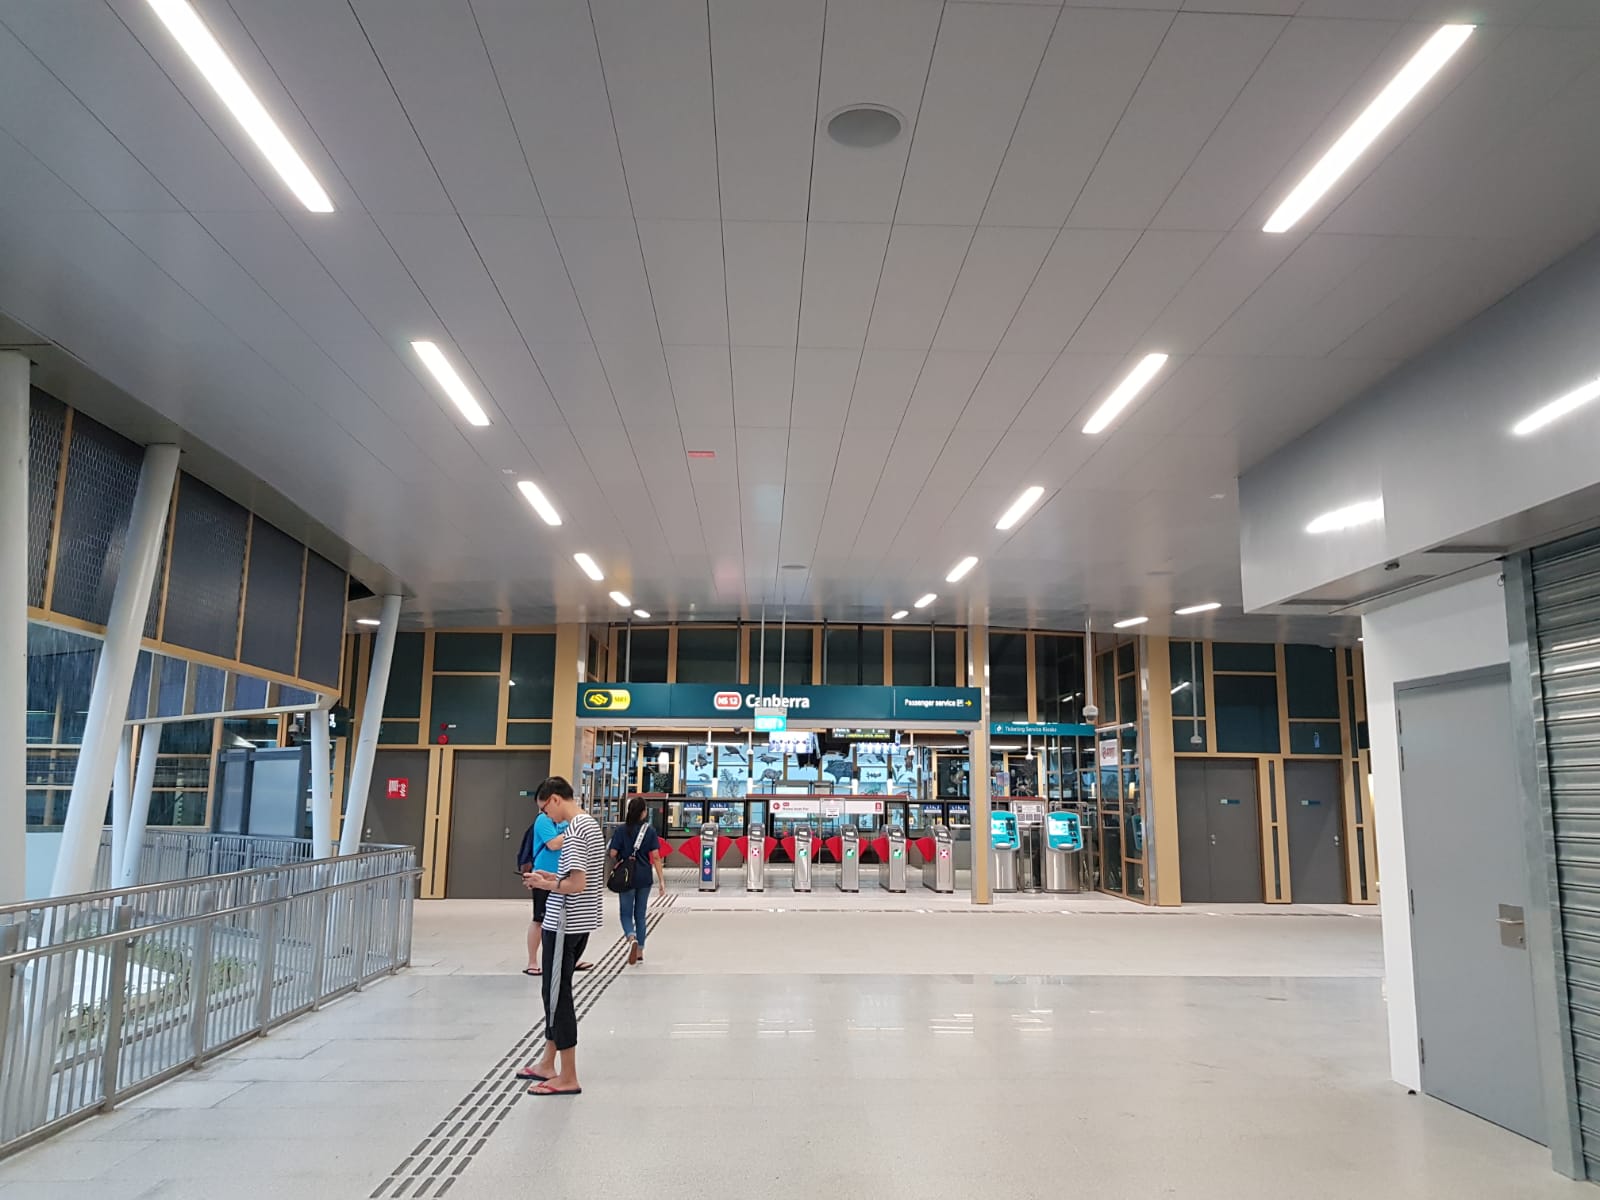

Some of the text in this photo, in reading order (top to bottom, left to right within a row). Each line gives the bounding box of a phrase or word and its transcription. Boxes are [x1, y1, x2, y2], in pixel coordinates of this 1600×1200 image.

[745, 694, 810, 708] Canberra
[904, 698, 956, 708] Passenger service
